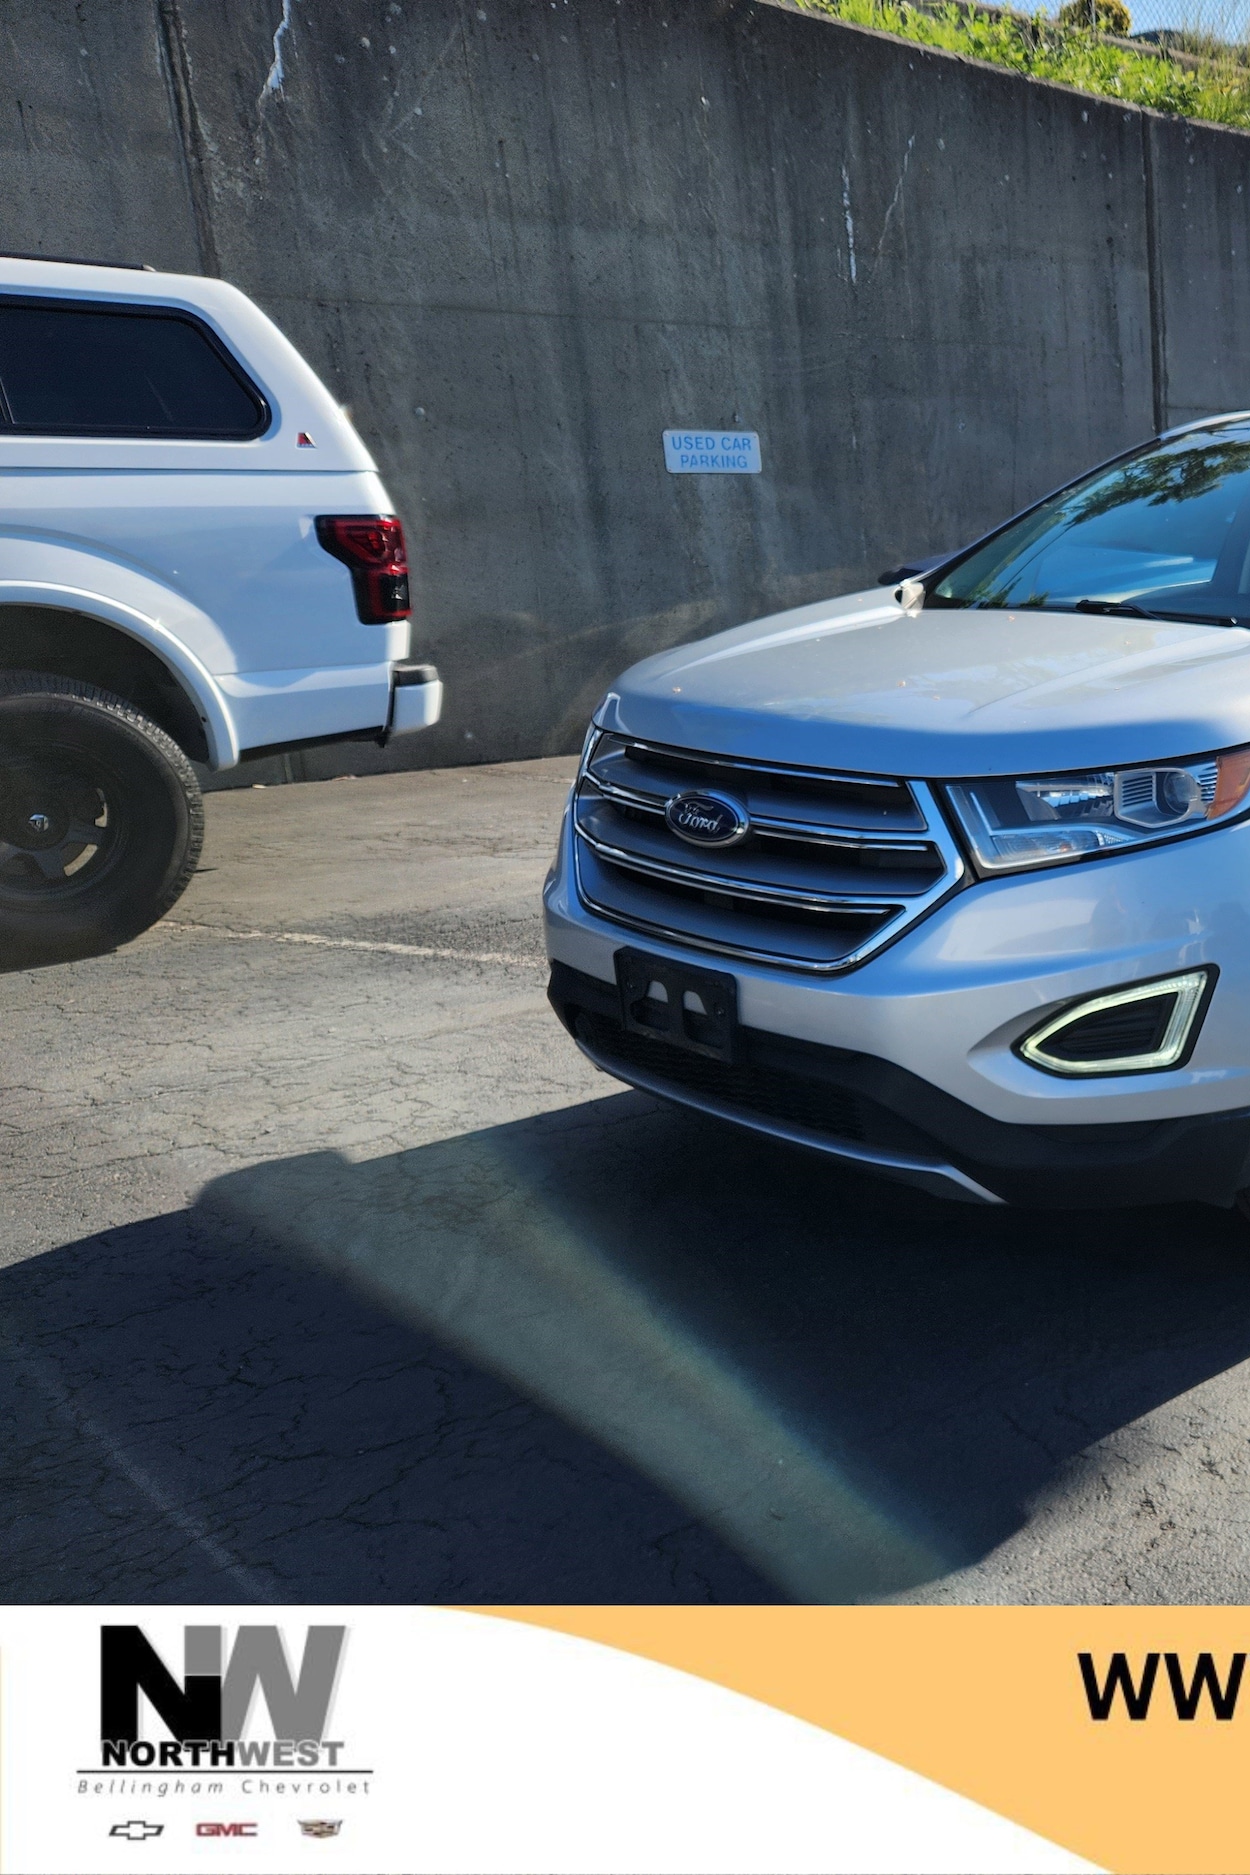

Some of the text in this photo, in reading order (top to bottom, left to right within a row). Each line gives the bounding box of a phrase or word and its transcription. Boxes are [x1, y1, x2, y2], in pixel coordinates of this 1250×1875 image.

[671, 436, 751, 451] USED CAR
[680, 454, 748, 469] PARKING
[678, 801, 723, 834] Ford
